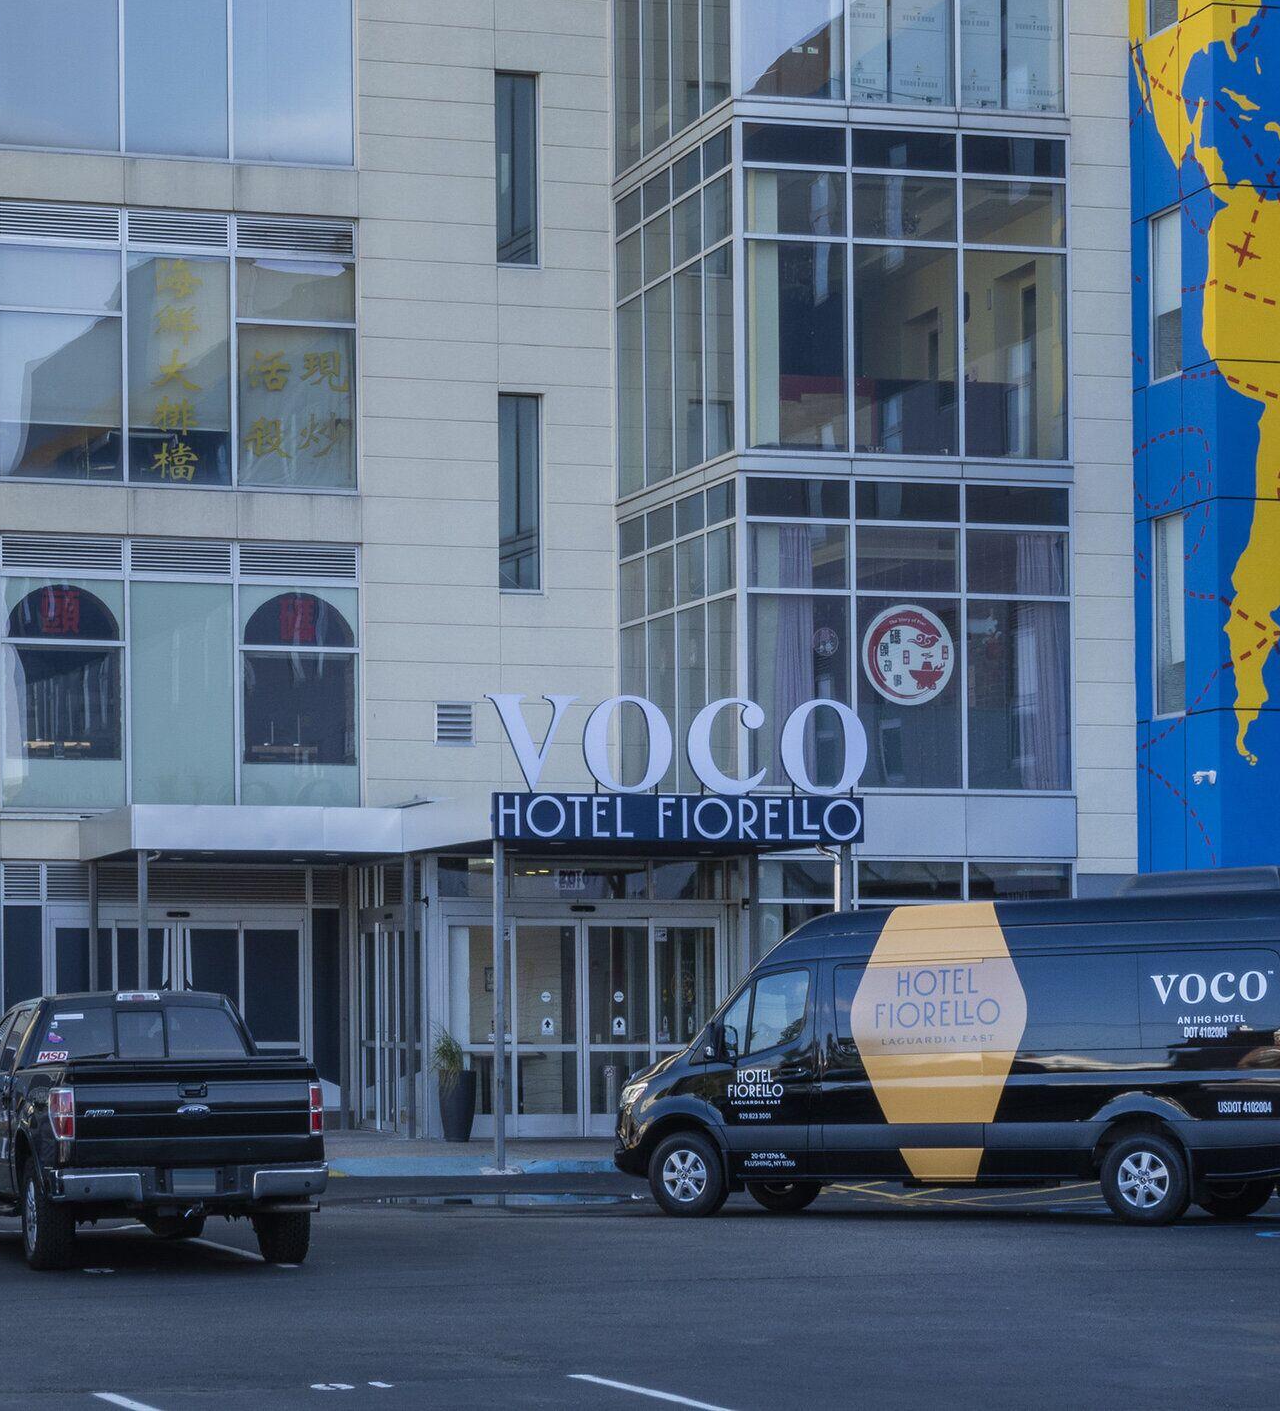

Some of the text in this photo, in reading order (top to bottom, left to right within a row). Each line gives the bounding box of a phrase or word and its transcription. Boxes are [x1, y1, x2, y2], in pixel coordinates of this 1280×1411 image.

[498, 795, 862, 841] HOTEL FIORELLO
[897, 968, 978, 997] HOTEL
[875, 998, 1000, 1029] FIORELLO
[1177, 1014, 1246, 1024] AN IHG HOTEL
[1184, 1027, 1228, 1038] DOT 4102004
[881, 1034, 995, 1046] LAGUARDIA EAST
[39, 1052, 66, 1061] MSD
[736, 1069, 773, 1083] HOTEL
[727, 1084, 784, 1097] FIORELLO
[1218, 1101, 1272, 1113] USDOT 4102004
